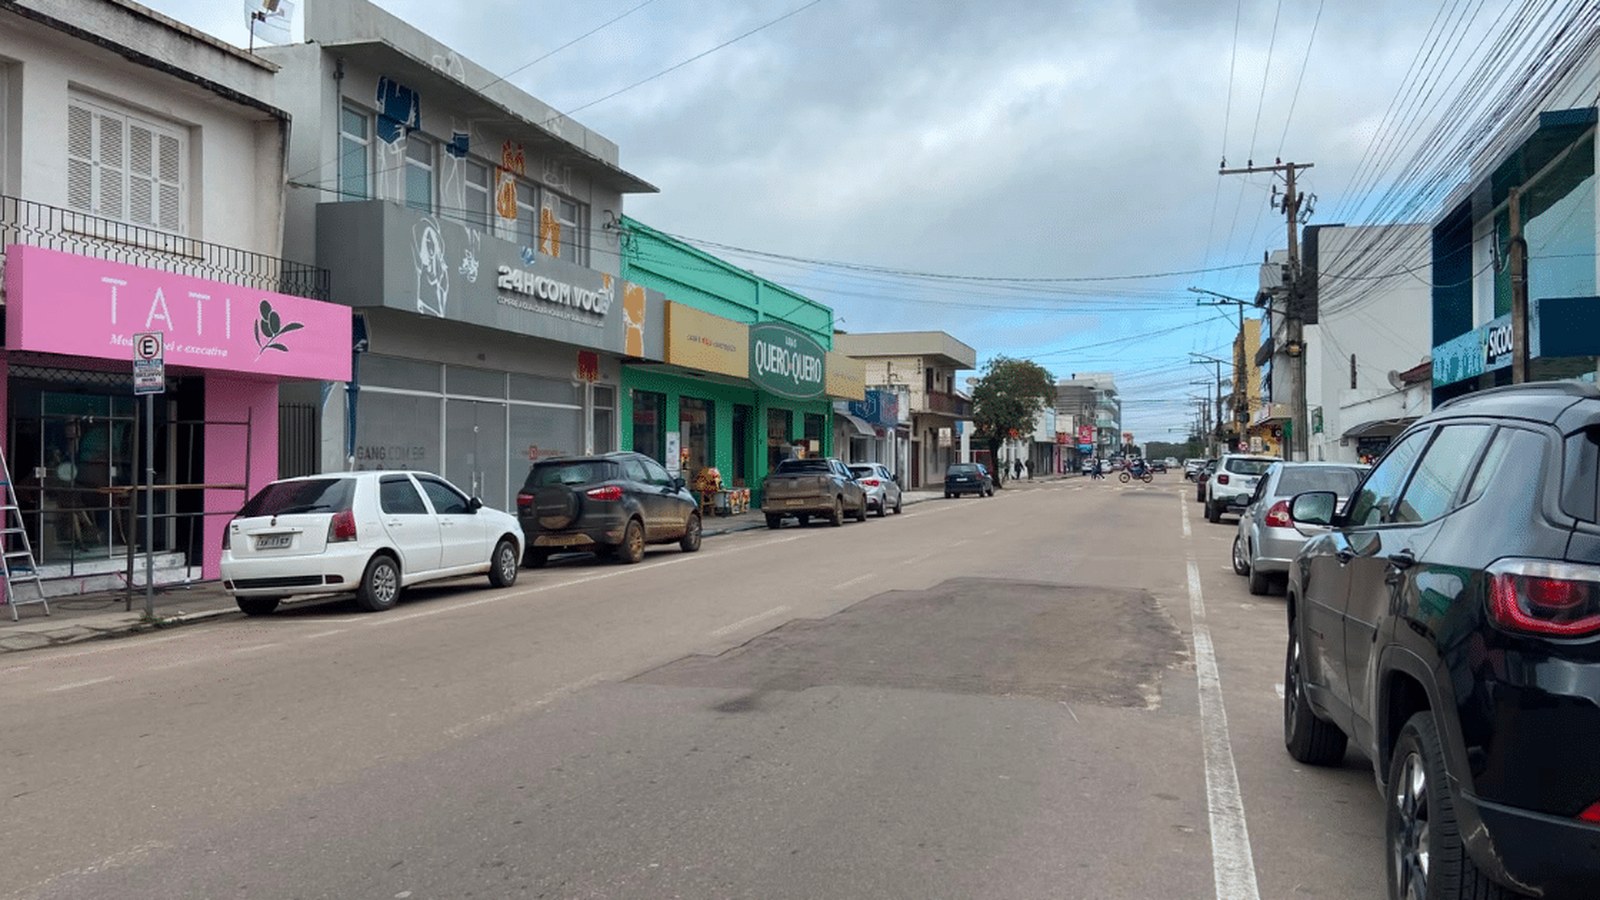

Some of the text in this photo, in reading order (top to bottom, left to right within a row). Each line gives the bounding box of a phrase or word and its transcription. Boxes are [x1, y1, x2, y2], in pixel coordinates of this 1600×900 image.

[498, 265, 535, 296] 24H
[536, 276, 571, 305] COM
[101, 277, 231, 340] TATI
[143, 339, 154, 355] E
[1489, 324, 1514, 357] SICOO
